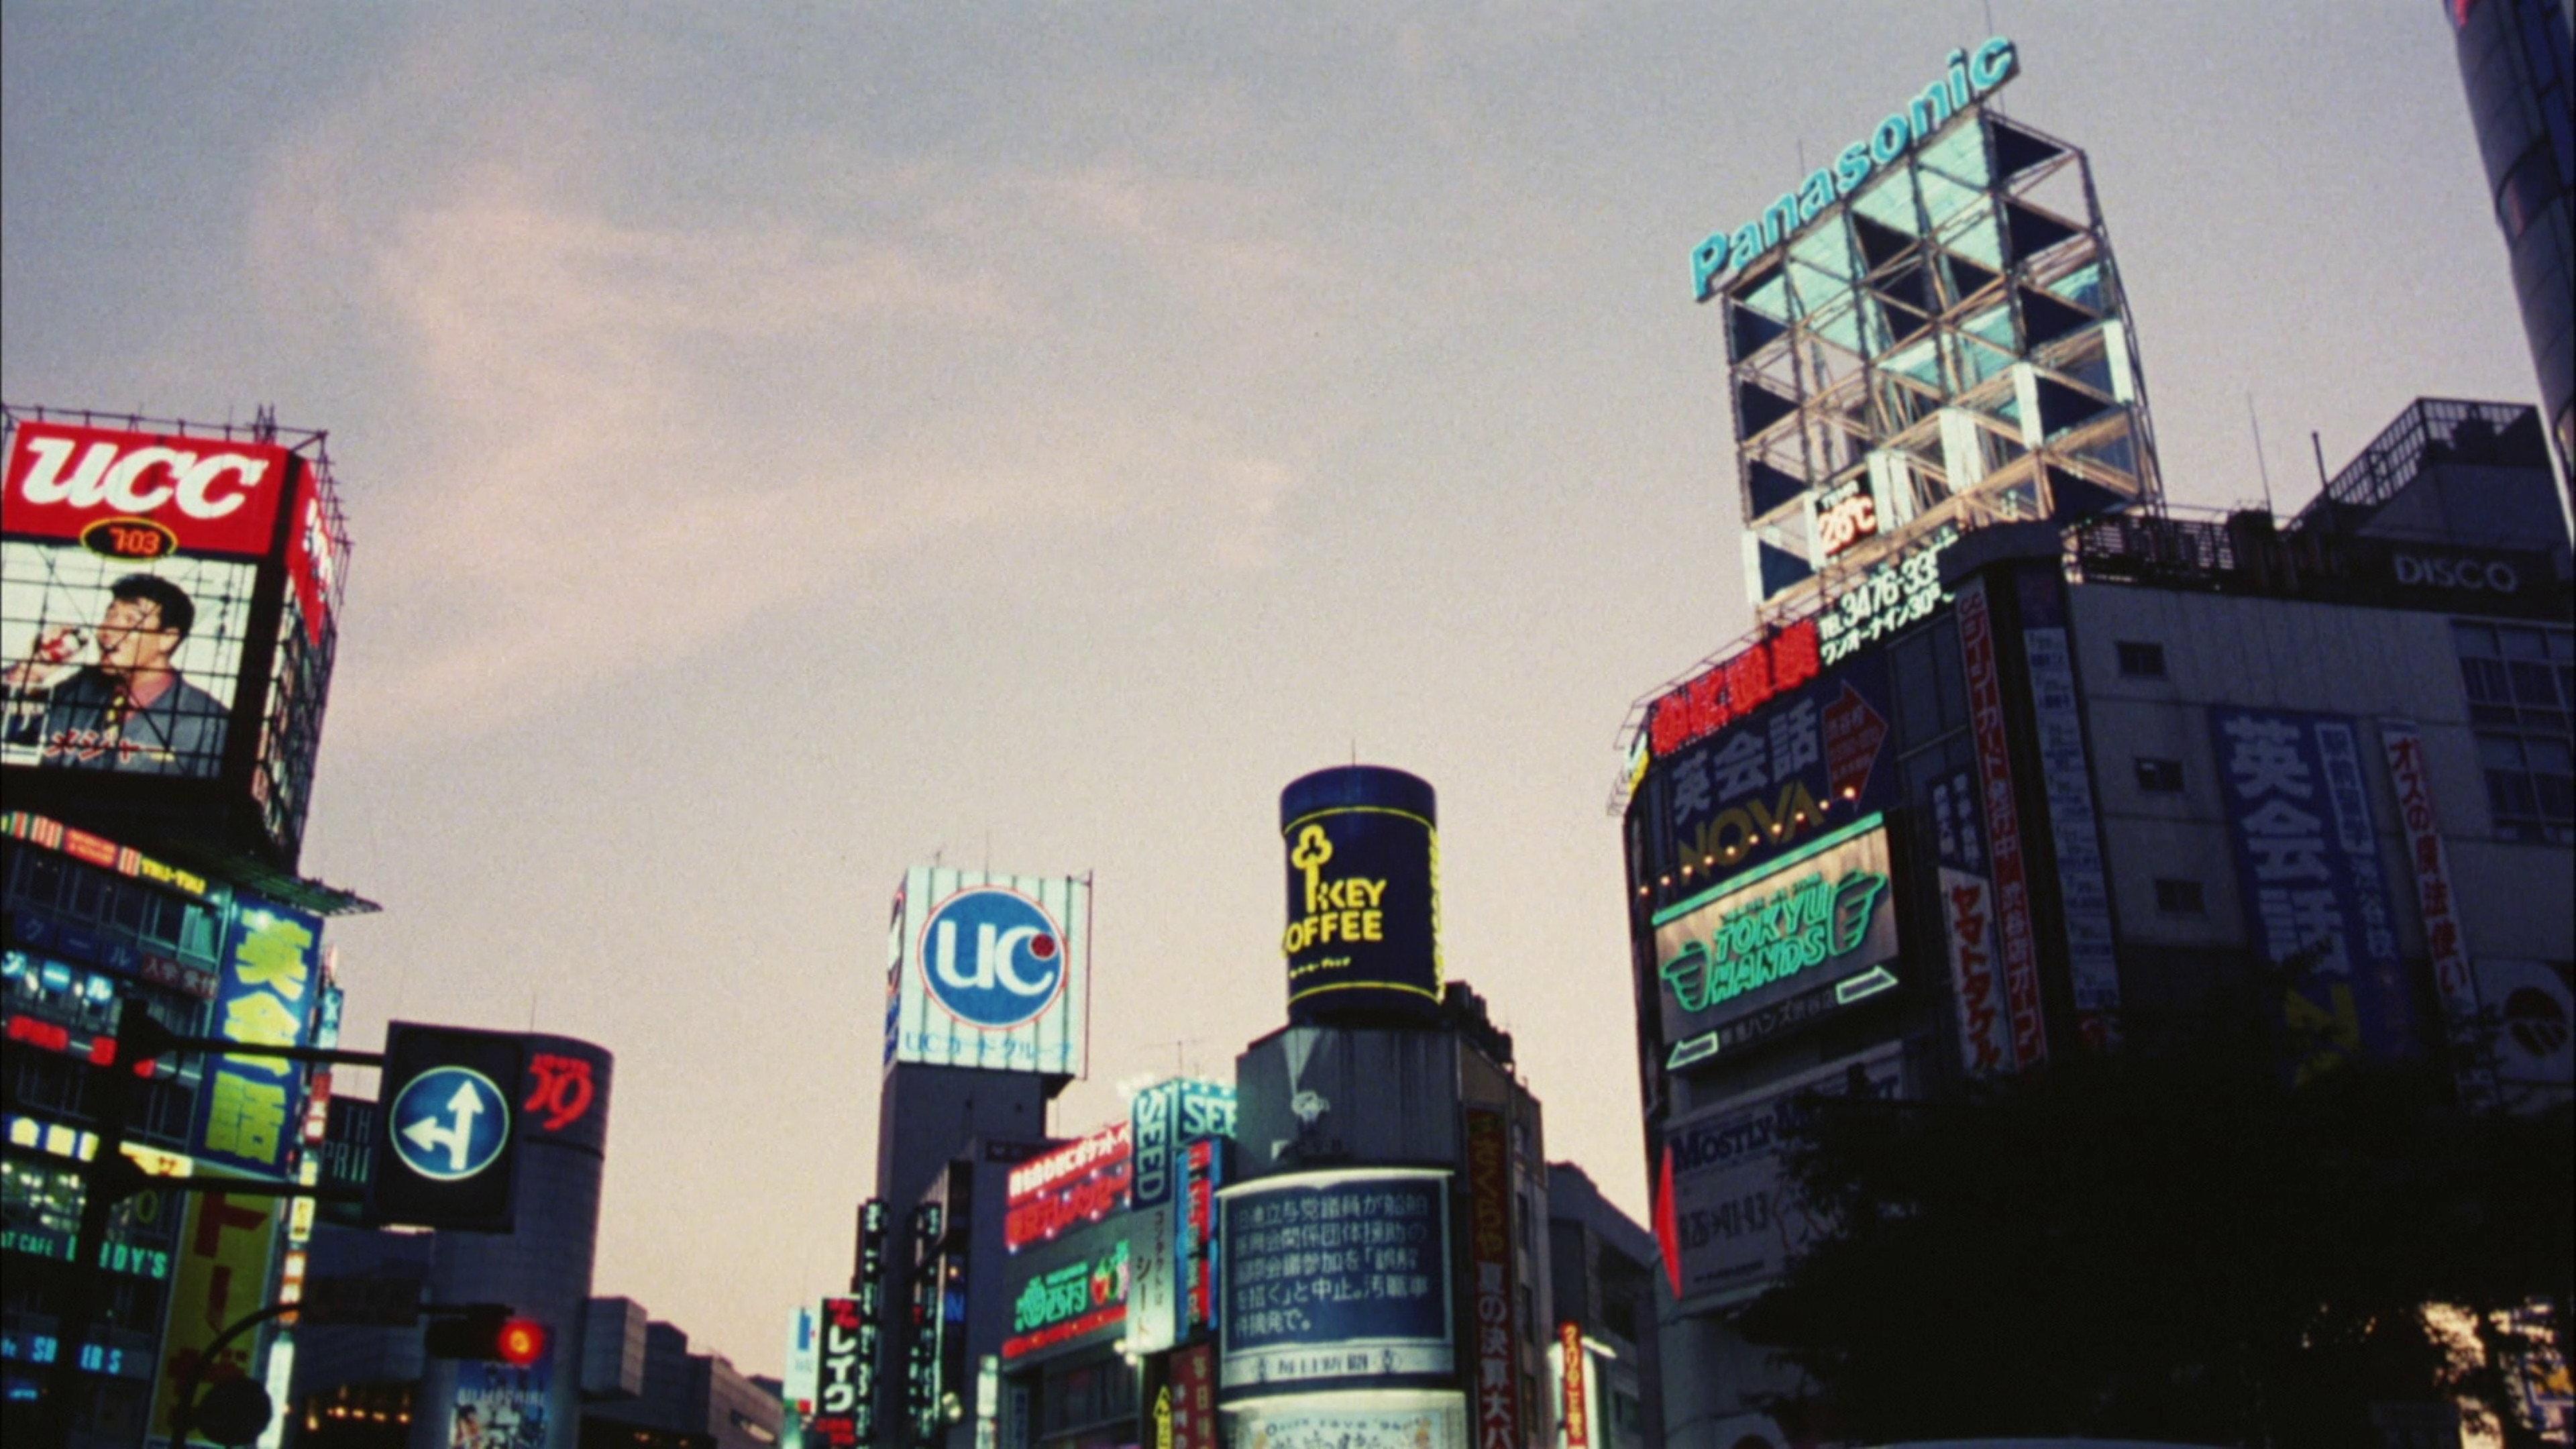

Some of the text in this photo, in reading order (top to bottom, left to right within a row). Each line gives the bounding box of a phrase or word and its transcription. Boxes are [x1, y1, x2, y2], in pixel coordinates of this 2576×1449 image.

[1691, 36, 2021, 303] Panasonic
[22, 437, 268, 519] UCC
[2394, 555, 2518, 593] DISCO
[1674, 698, 1819, 826] 英会話
[1677, 780, 1826, 887] NOVA
[2224, 717, 2357, 975] 英会話
[1284, 910, 1383, 953] OFFEE
[1320, 877, 1387, 913] KEY
[1713, 880, 1830, 961] TOKYU
[936, 920, 1055, 996] UC
[1712, 927, 1826, 1004] HANDS
[207, 909, 313, 1165] 英会話
[1136, 1092, 1167, 1199] SEED
[1183, 1095, 1237, 1136] SEE
[824, 1324, 859, 1413] レイク
